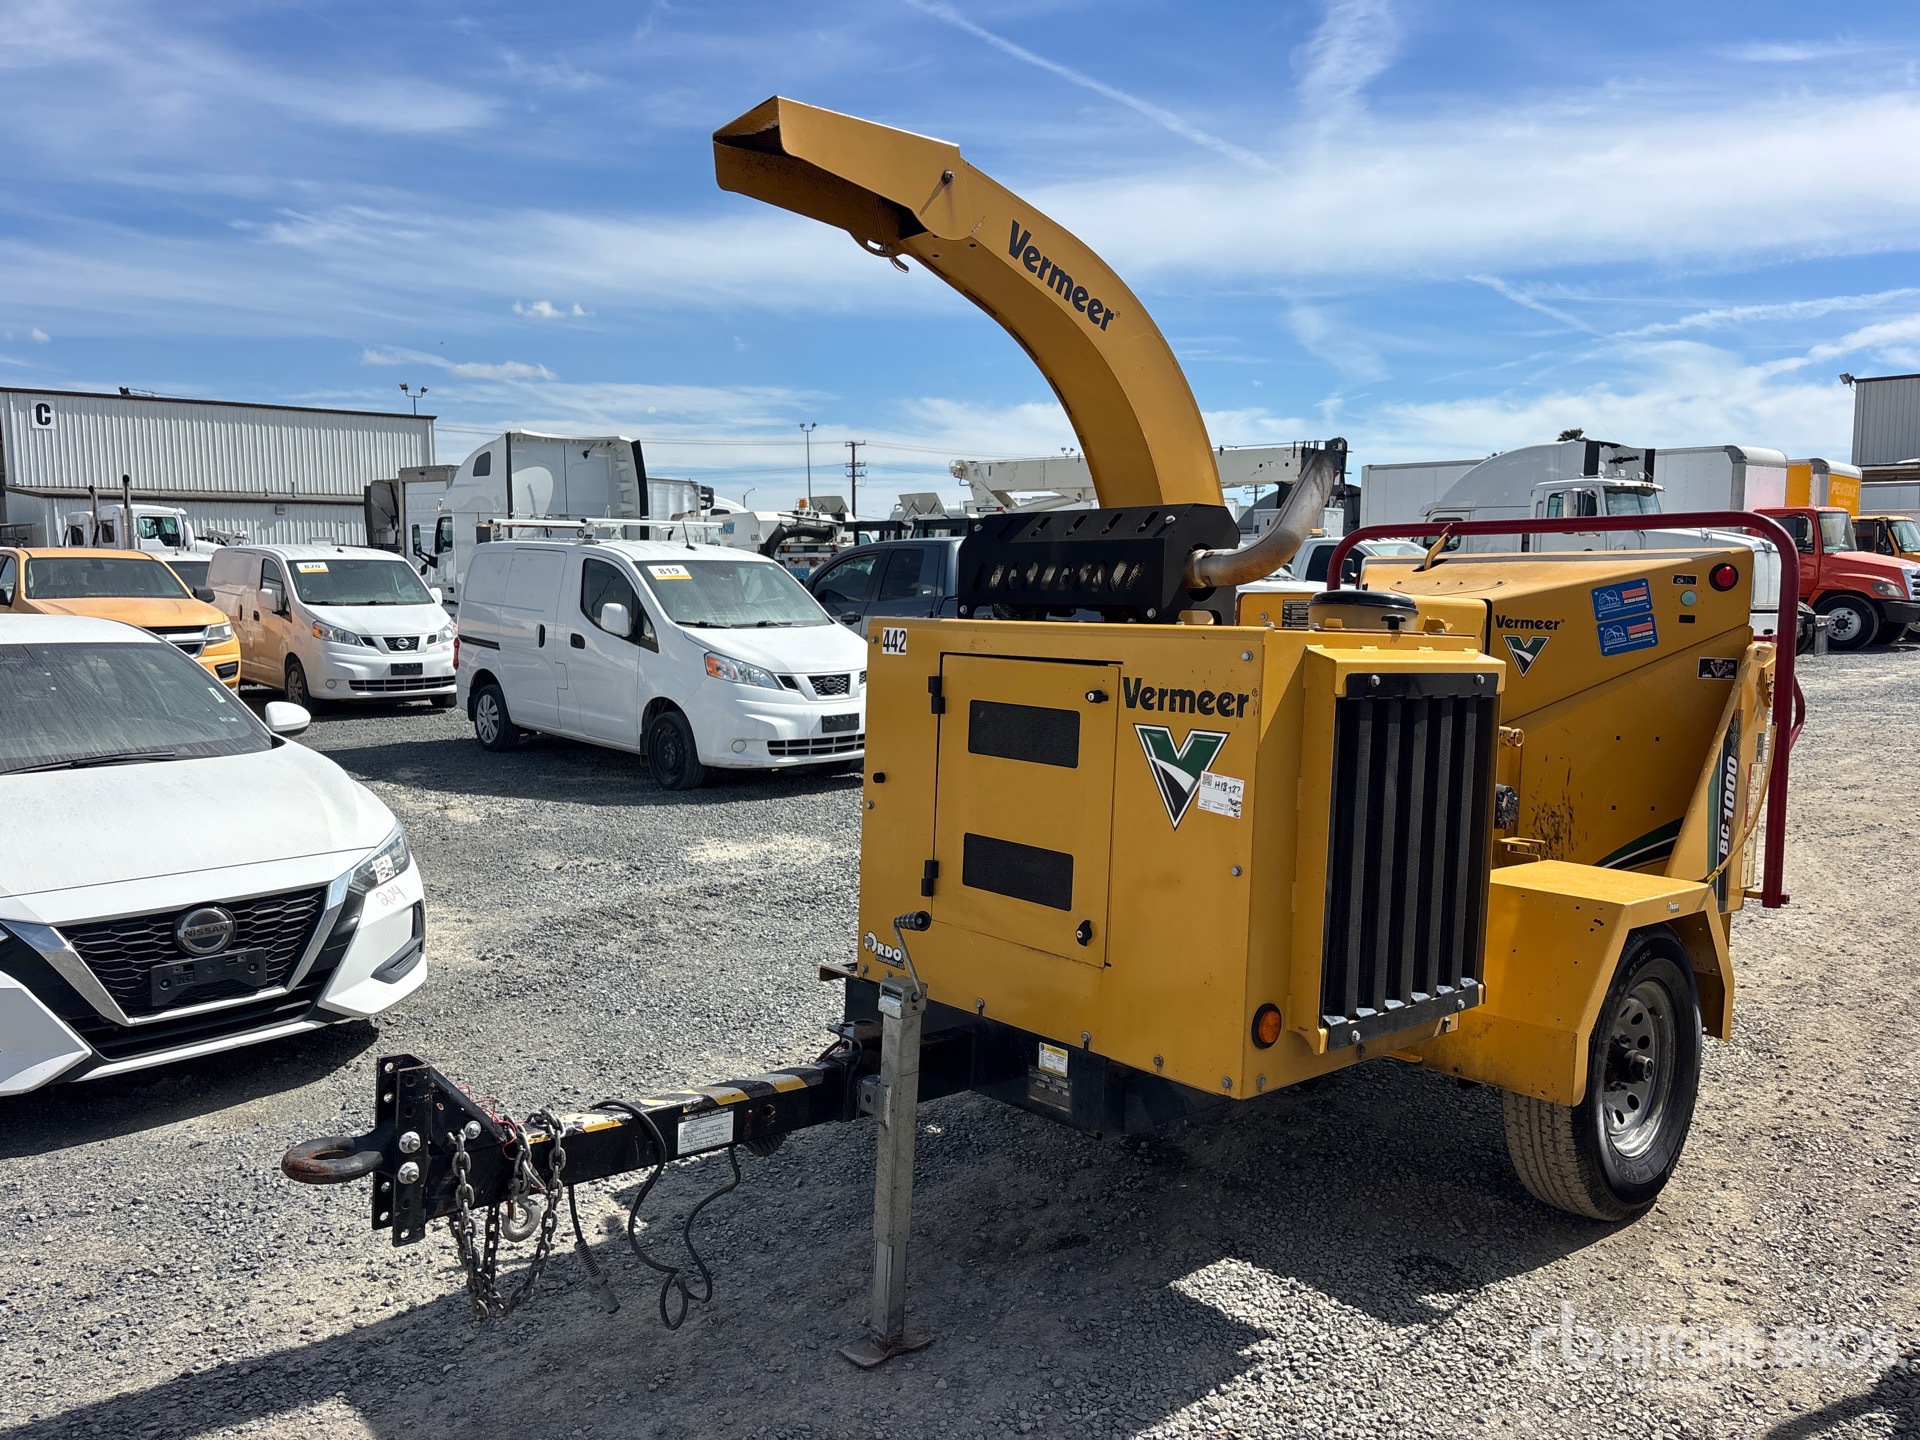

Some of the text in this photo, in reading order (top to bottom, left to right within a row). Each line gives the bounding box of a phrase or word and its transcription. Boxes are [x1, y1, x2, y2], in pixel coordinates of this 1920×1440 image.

[1009, 219, 1114, 332] Vermeer
[36, 403, 51, 425] C
[658, 567, 680, 575] 819
[1495, 614, 1561, 631] Vermeer
[883, 629, 906, 653] 442
[1122, 676, 1250, 719] Vermeer
[1723, 755, 1738, 819] 1000
[1719, 823, 1730, 855] BC
[375, 884, 407, 907] 204
[183, 924, 229, 938] NISSAN
